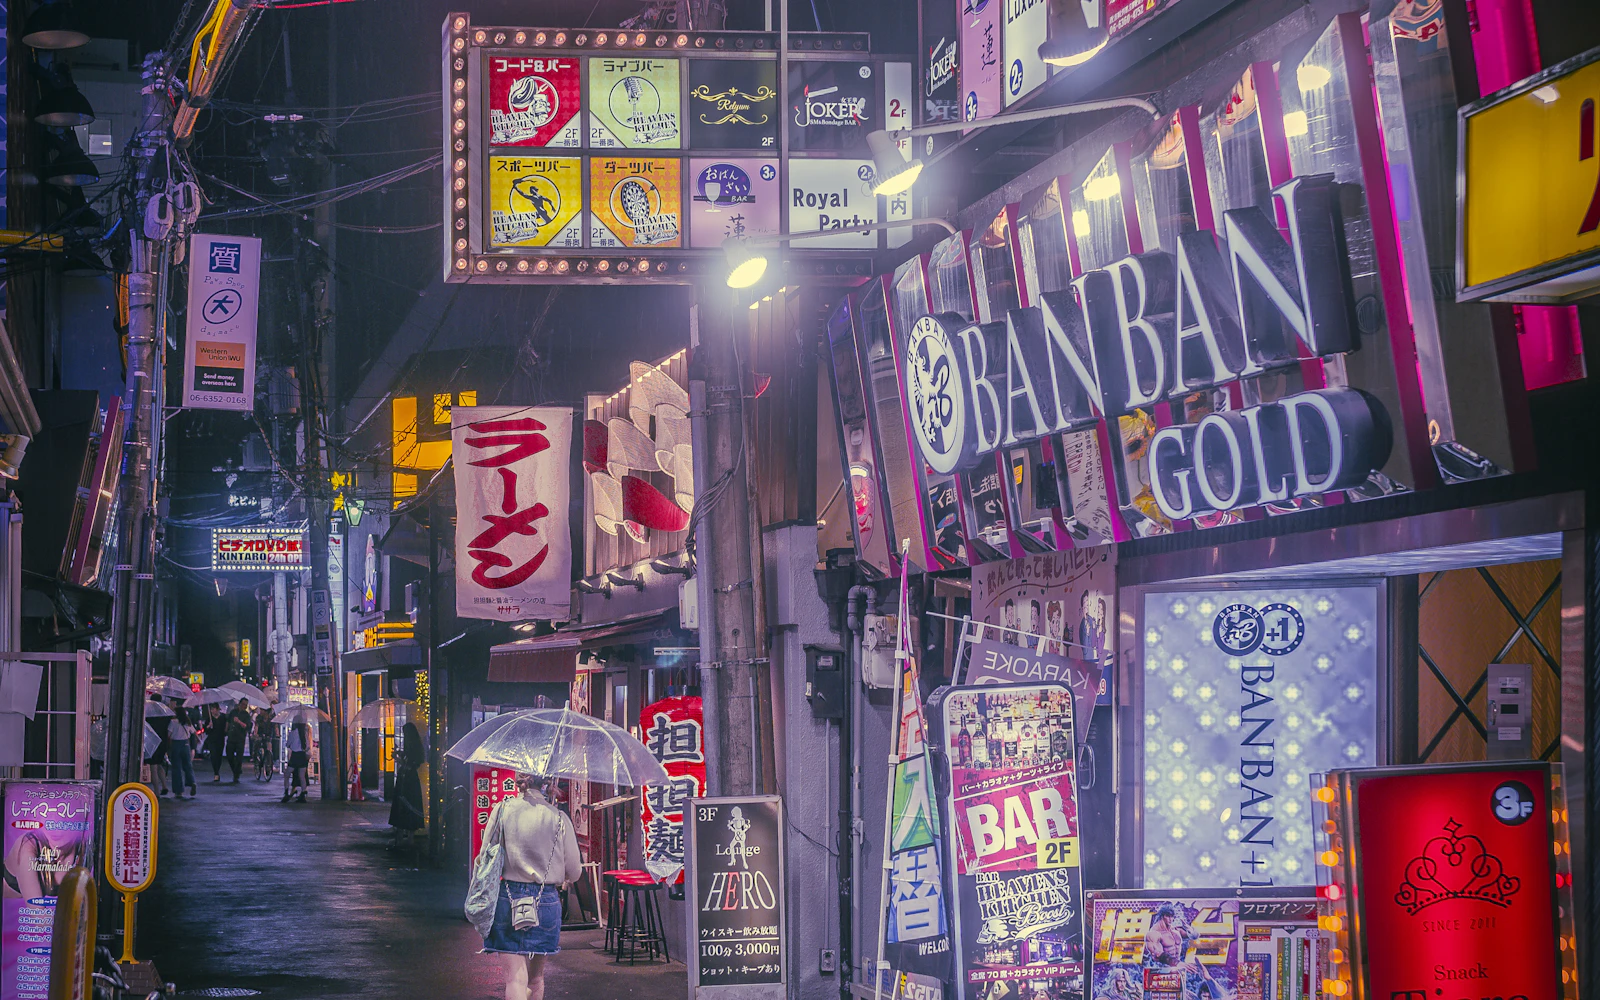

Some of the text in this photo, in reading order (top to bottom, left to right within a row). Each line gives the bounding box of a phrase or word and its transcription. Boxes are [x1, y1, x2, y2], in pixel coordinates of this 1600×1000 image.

[926, 52, 958, 97] JOKER
[1010, 62, 1023, 96] 2F
[795, 101, 869, 127] JOKER
[889, 98, 907, 118] 2F
[967, 95, 977, 122] 3F
[565, 128, 579, 138] 2F
[591, 128, 604, 138] 2F
[761, 137, 774, 147] 2F
[496, 160, 571, 173] スポーツバー
[605, 161, 665, 174] ダーツバー
[762, 166, 774, 179] 3F
[859, 166, 872, 179] 2F
[706, 168, 739, 181] おばん
[793, 188, 848, 210] Royal
[819, 214, 874, 236] Party
[566, 228, 580, 239] 2F
[592, 228, 605, 238] 2F
[211, 247, 239, 272] 質
[907, 318, 948, 364] BANBAN
[200, 346, 228, 356] Western
[201, 379, 224, 387] overseas
[203, 372, 235, 382] Send money
[190, 394, 247, 404] 06-6352-0168
[1148, 392, 1344, 520] GOLD
[463, 417, 551, 590] ラーメン
[219, 552, 266, 561] KINTARO
[268, 553, 286, 563] 24h
[497, 605, 520, 614] ササラ
[1219, 605, 1260, 619] BANBAN
[1266, 617, 1290, 642] +1
[1495, 786, 1533, 820] 3F
[698, 807, 719, 822] 3F
[965, 786, 1071, 858] BAR
[122, 813, 141, 884] 駐輪禁止
[1045, 841, 1071, 864] 2F
[976, 871, 1000, 883] BAR
[702, 870, 776, 912] HERO
[976, 868, 1069, 903] HEAVENS
[979, 886, 1071, 920] KITCHEN
[1015, 902, 1070, 928] Boost
[701, 925, 778, 937] ウイスキー飲み放題
[1422, 917, 1497, 932] SINCE 2011
[701, 942, 780, 957] 100分 3,000円
[987, 970, 999, 978] 70
[1043, 966, 1058, 975] VIP
[1059, 965, 1081, 974] ルーム
[1433, 963, 1489, 981] Snack
